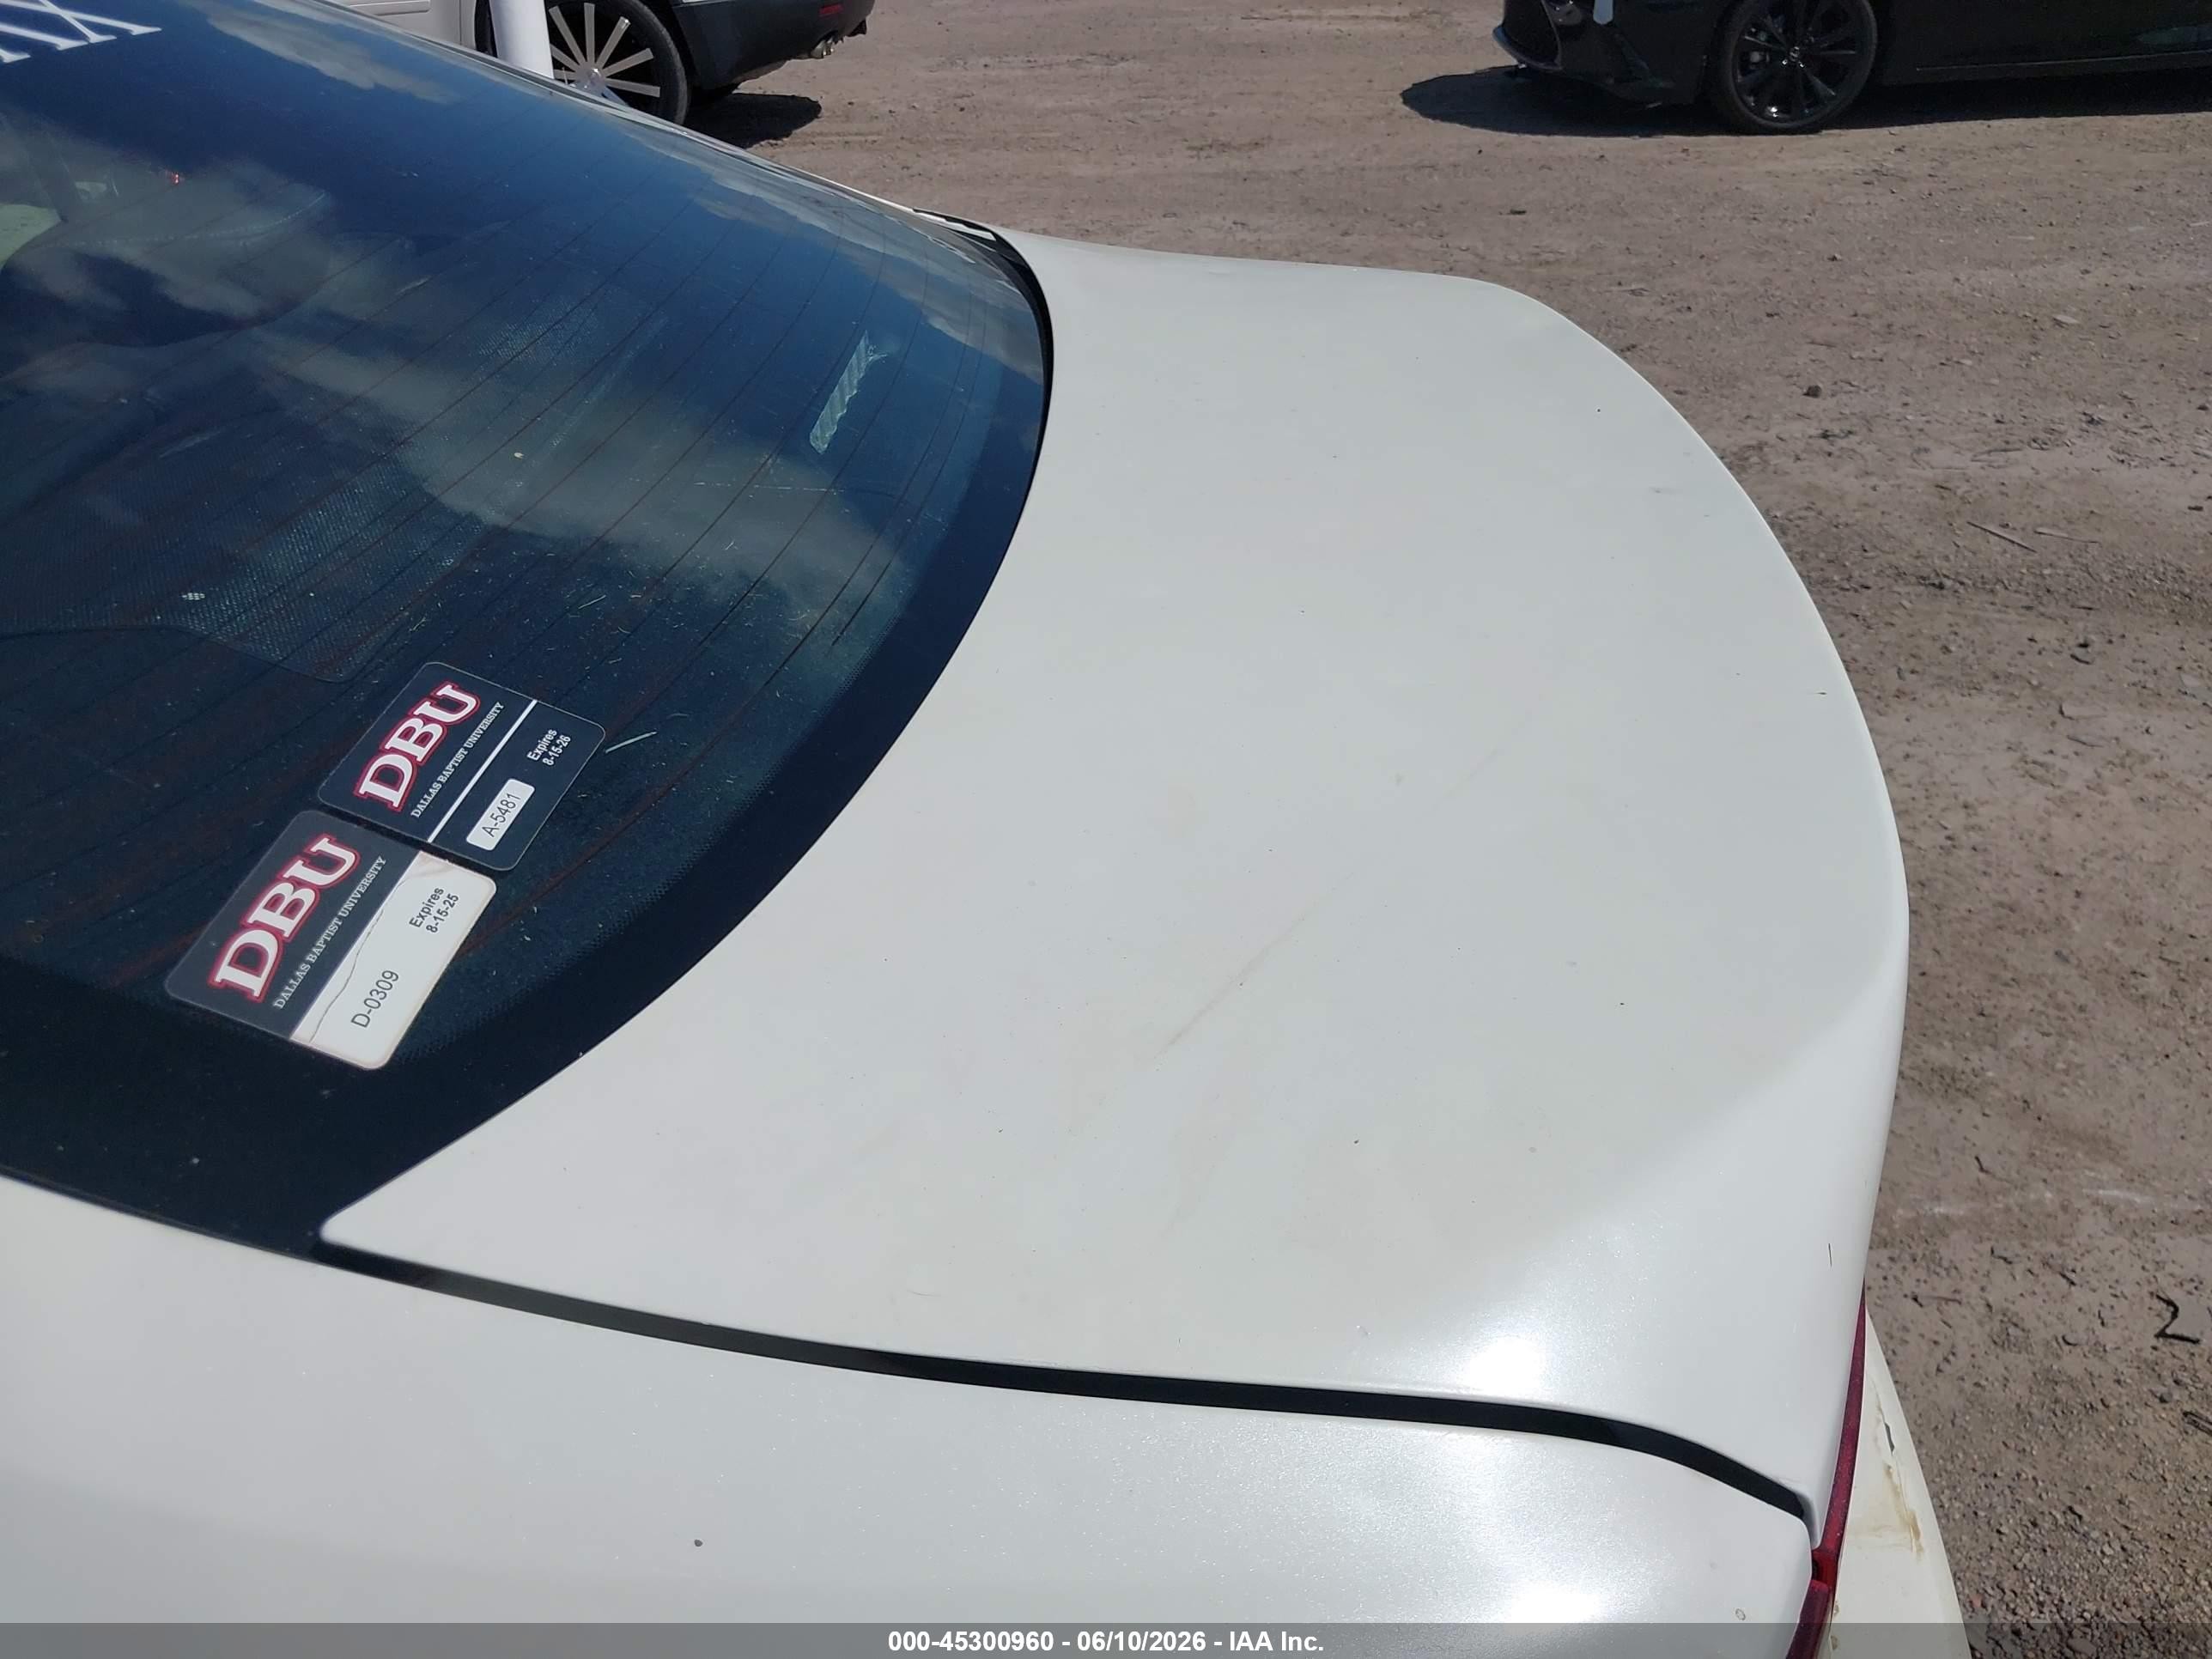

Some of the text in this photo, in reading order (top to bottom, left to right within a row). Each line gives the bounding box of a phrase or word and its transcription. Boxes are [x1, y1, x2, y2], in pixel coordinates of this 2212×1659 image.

[356, 683, 479, 810] DBU
[410, 702, 505, 818] DALLAS BAPTIST UNIVERSITY
[527, 729, 557, 761] Expires
[542, 735, 571, 766] 8-15-26
[482, 793, 521, 837] A-5481
[211, 835, 359, 1000] DBU
[273, 856, 386, 1009] DALLAS BAPTIST UNIVERSITY
[409, 887, 444, 927] Expires
[426, 894, 459, 933] 8-15-25
[350, 969, 399, 1029] D-0309
